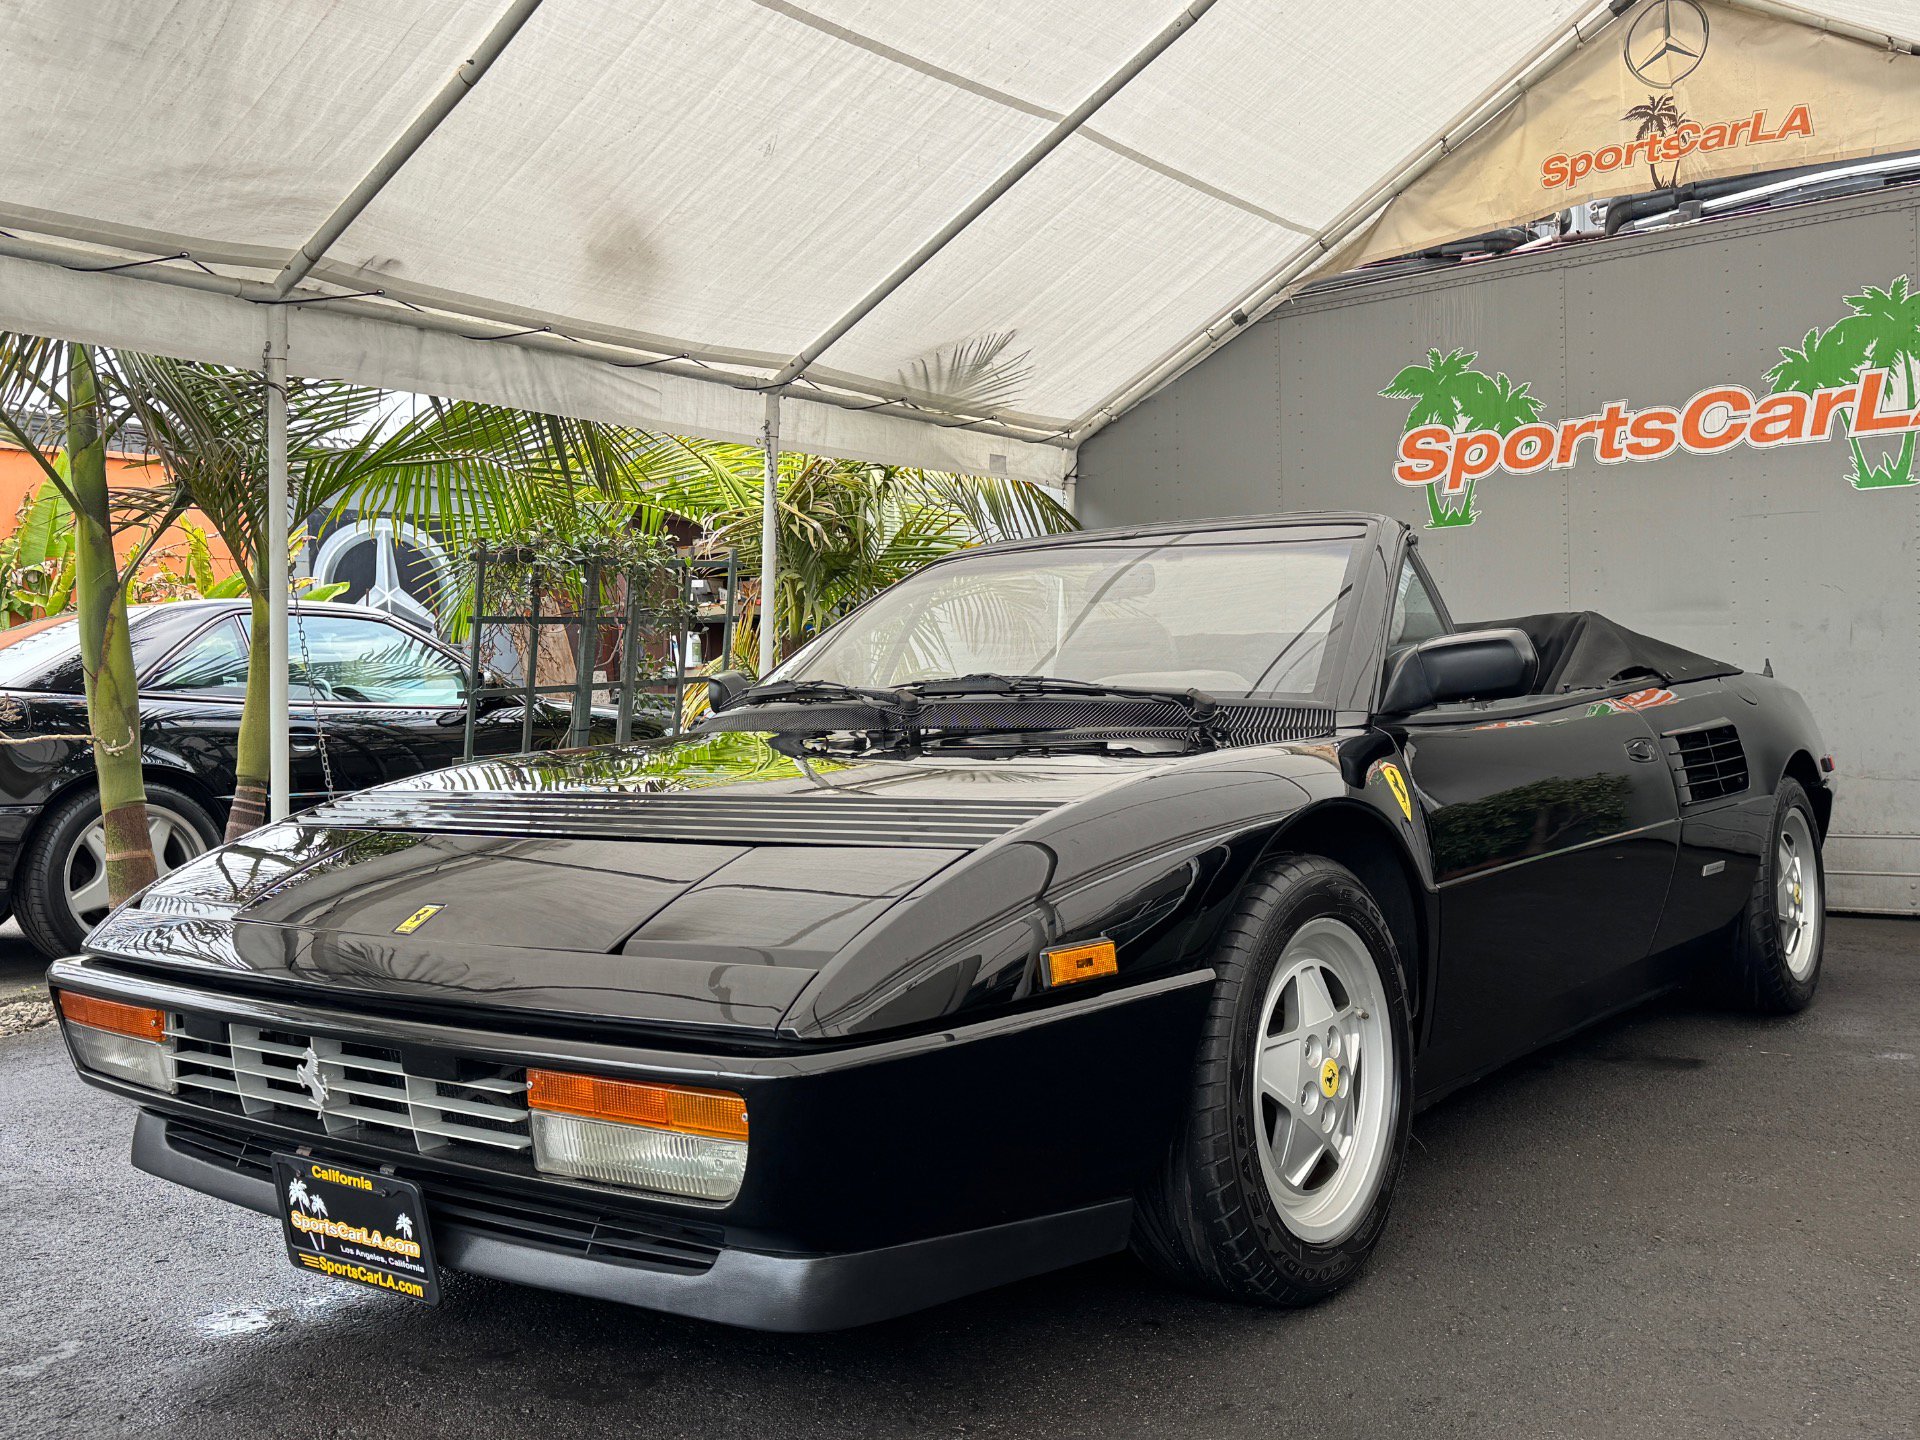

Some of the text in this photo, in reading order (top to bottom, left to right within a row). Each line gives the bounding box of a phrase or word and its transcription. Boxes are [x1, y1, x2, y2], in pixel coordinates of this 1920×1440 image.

[1541, 104, 1814, 189] SportsCarLA
[1395, 368, 1920, 494] SportsCarL
[311, 1165, 373, 1190] California
[291, 1210, 420, 1258] SportsCarLA.com
[318, 1256, 424, 1298] SportsCarLA.com
[340, 1244, 354, 1255] Los
[388, 1257, 425, 1273] California
